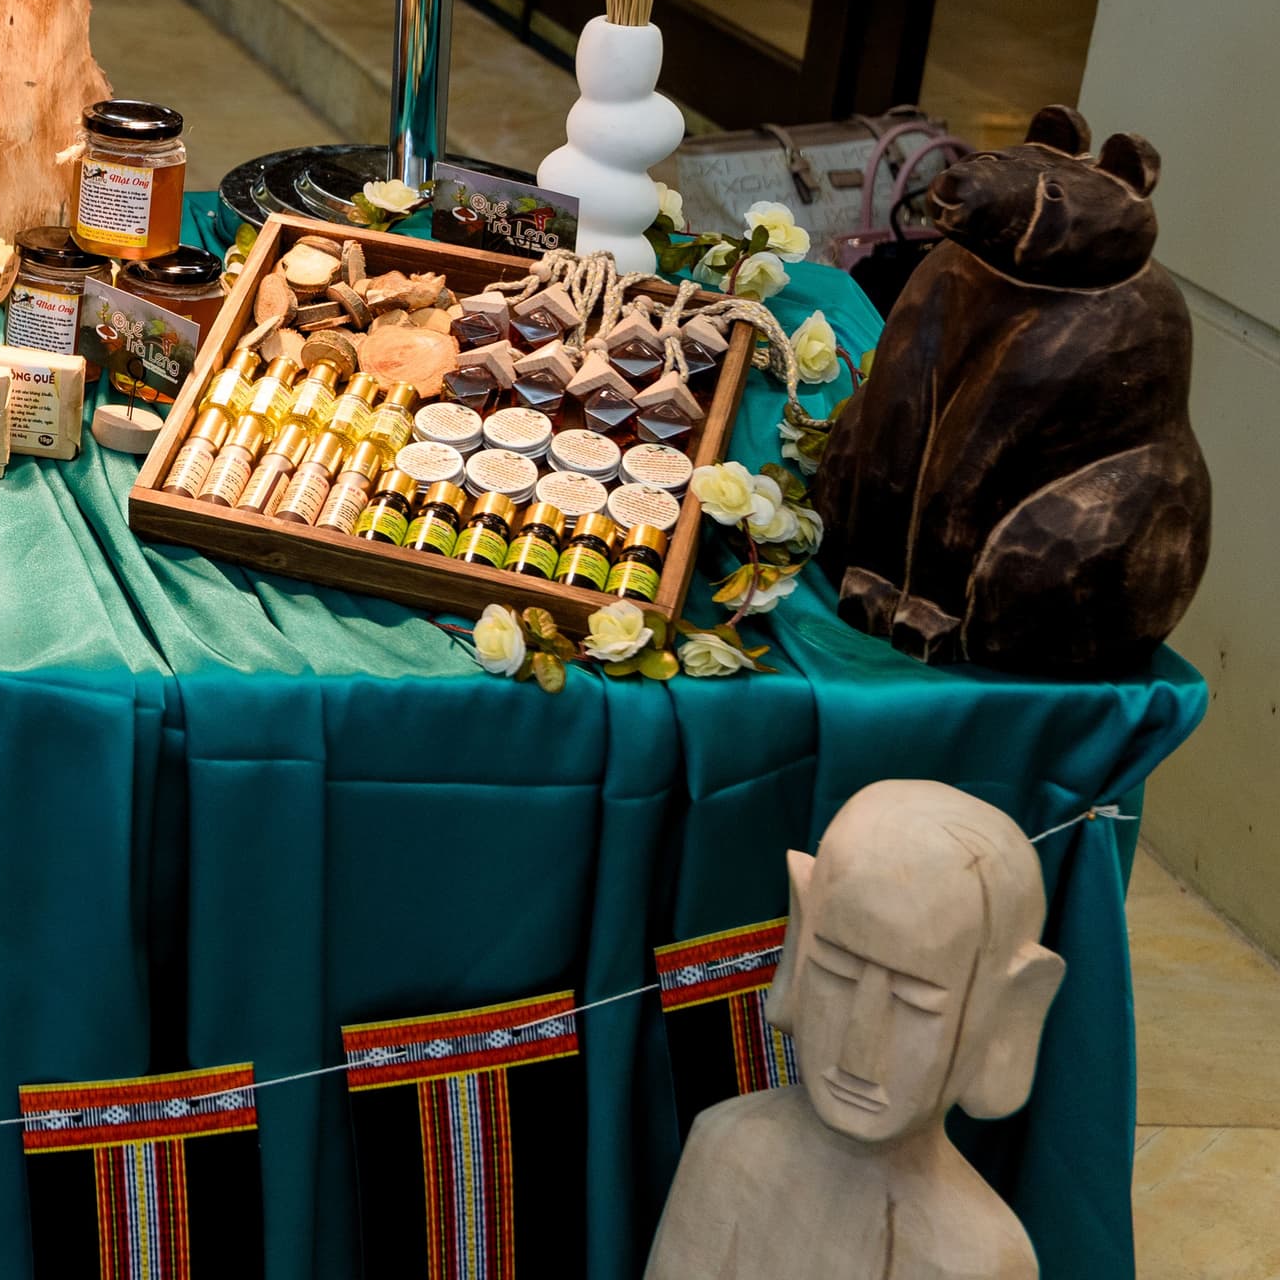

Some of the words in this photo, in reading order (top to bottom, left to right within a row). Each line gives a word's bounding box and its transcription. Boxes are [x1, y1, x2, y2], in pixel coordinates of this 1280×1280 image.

[109, 173, 130, 186] Mật
[132, 177, 150, 189] Ong
[470, 193, 510, 218] Quế
[515, 221, 559, 250] Leng
[35, 299, 56, 312] Mật
[57, 304, 75, 315] Ong
[111, 311, 145, 338] Quế
[124, 331, 146, 358] Trà
[148, 343, 180, 377] Leng
[33, 371, 56, 385] QUẾ
